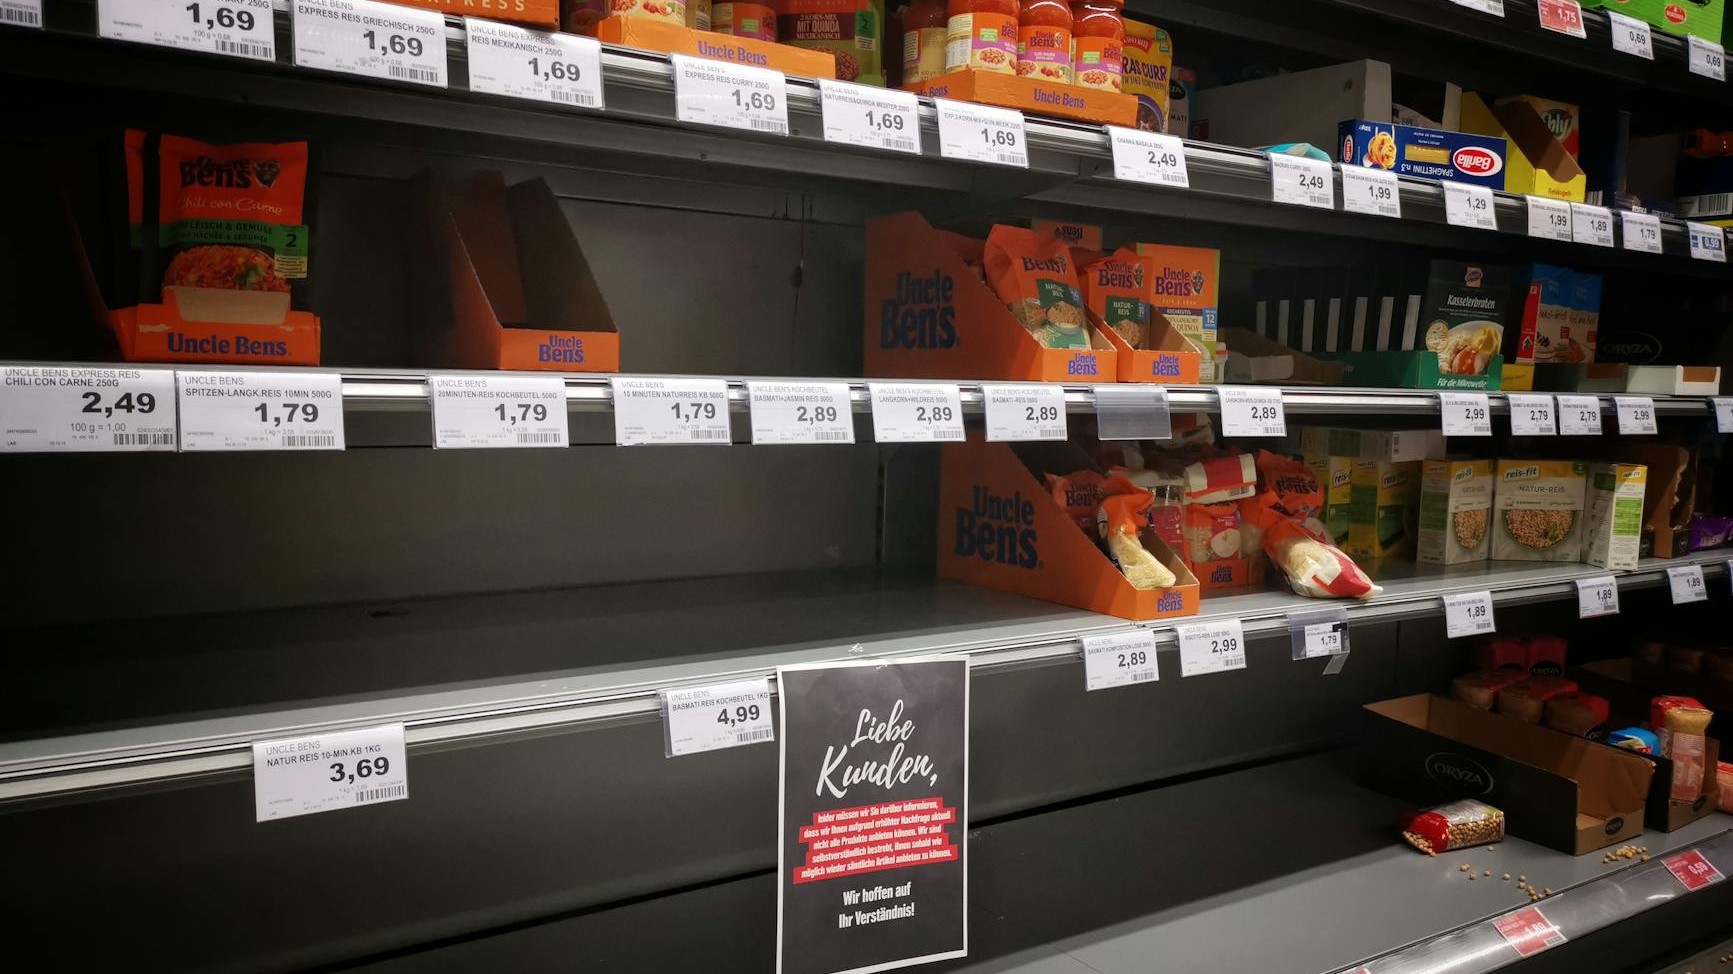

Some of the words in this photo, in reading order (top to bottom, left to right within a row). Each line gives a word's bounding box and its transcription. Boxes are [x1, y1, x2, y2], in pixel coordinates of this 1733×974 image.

[186, 3, 255, 31] 1,69
[298, 5, 339, 19] EXPRESS
[341, 13, 361, 24] REIS
[363, 17, 414, 32] GRIECHISCH
[416, 25, 435, 36] 250G
[1557, 7, 1577, 23] 1,75
[811, 21, 840, 33] QUINOA
[862, 20, 871, 29] 2
[363, 30, 423, 57] 1,69
[470, 24, 497, 36] UNCLE
[520, 33, 557, 46] EXPRESS
[1629, 31, 1647, 45] 0,69
[471, 35, 490, 45] REIS
[491, 38, 543, 55] MEXIKANISCH
[544, 46, 564, 58] 250G
[698, 41, 735, 60] Uncle
[528, 57, 581, 82] 1,69
[1706, 54, 1722, 68] 0,69
[684, 71, 716, 82] EXPRESS
[717, 74, 732, 84] REIS
[732, 78, 753, 88] CURRY
[731, 89, 776, 112] 1,69
[1034, 88, 1060, 105] Uncle
[865, 110, 904, 132] 1,69
[981, 128, 1016, 148] 1,69
[1147, 150, 1177, 168] 2,49
[1457, 153, 1492, 172] Barilla
[1298, 174, 1324, 189] 2,49
[1368, 184, 1391, 200] 1,99
[1466, 196, 1487, 211] 1,29
[1549, 214, 1567, 227] 1,99
[1590, 219, 1607, 233] 1,89
[286, 233, 297, 248] 2
[1640, 228, 1656, 241] 1,79
[1163, 266, 1191, 281] Uncle
[896, 269, 954, 306] Uncle
[1446, 293, 1496, 310] Kasselerbraten
[1205, 313, 1215, 324] 12
[167, 331, 231, 355] Uncle
[549, 335, 584, 349] Uncle
[1074, 352, 1098, 366] Uncle
[1158, 353, 1181, 367] Uncle
[5, 369, 38, 378] UNCLE
[41, 369, 69, 379] BENS
[70, 370, 117, 379] EXPRESS
[118, 370, 141, 380] REIS
[5, 377, 32, 387] CHILI
[34, 378, 57, 387] CON
[59, 378, 94, 388] CARNE
[96, 379, 120, 388] 250G
[185, 376, 216, 386] UNCLE
[219, 377, 245, 386] BENS
[437, 380, 463, 388] UNCLE
[284, 389, 309, 399] 10MIN
[311, 389, 332, 399] 500G
[496, 391, 540, 399] KOCHBEUTEL
[623, 390, 631, 398] 10
[632, 390, 661, 398] MINUTEN
[662, 391, 699, 399] NATURREIS
[81, 391, 156, 418] 2,49
[671, 402, 717, 424] 1,79
[254, 402, 319, 428] 1,79
[494, 403, 547, 427] 1,79
[796, 405, 838, 426] 2,89
[916, 406, 953, 425] 2,89
[1025, 406, 1057, 424] 2,89
[1251, 406, 1277, 422] 2,89
[1465, 408, 1485, 422] 2,99
[1530, 410, 1549, 423] 2,79
[1580, 411, 1598, 423] 2,79
[1634, 410, 1650, 423] 2,99
[71, 423, 86, 432] 100
[89, 425, 96, 434] g
[1504, 466, 1538, 479] reis-fit
[1519, 485, 1566, 494] NATUR-REIS
[973, 484, 1035, 526] Uncle
[1686, 576, 1702, 589] 1,89
[1162, 590, 1183, 602] Uncle
[1596, 588, 1613, 603] 1,89
[1467, 605, 1486, 620] 1,89
[1211, 638, 1238, 655] 2,99
[1320, 634, 1338, 646] 1,79
[1117, 651, 1147, 670] 2,89
[672, 702, 700, 711] BASMATI
[700, 699, 715, 708] REIS
[716, 694, 755, 706] KOCHBEUTEL
[756, 691, 769, 700] 1KG
[716, 704, 760, 728] 4,99
[850, 699, 916, 749] Liebe
[266, 744, 296, 756] UNCLE
[297, 740, 321, 751] BENS
[266, 755, 298, 768] NATUR
[299, 753, 320, 763] REIS
[364, 744, 382, 754] 1KG
[329, 756, 390, 785] 3,69
[815, 742, 939, 799] Kunden,
[1432, 761, 1484, 788] ORYZA
[818, 813, 835, 824] leider
[835, 811, 859, 822] müssen
[859, 809, 870, 818] wir
[870, 807, 880, 816] Sie
[880, 804, 903, 815] darüber
[903, 801, 938, 814] informieren,
[804, 828, 820, 839] dass
[820, 827, 831, 837] wir
[831, 824, 848, 835] Ihnen
[848, 821, 875, 834] aufgrund
[874, 817, 900, 829] erhöhter
[901, 814, 931, 826] Nachfrage
[930, 811, 951, 822] aktuell
[813, 840, 829, 851] nicht
[829, 838, 841, 849] alle
[841, 834, 868, 847] Produkte
[868, 831, 894, 843] anbieten
[893, 828, 917, 840] können.
[917, 826, 928, 836] Wir
[928, 824, 942, 834] sind
[812, 847, 867, 864] selbstverständlich
[866, 844, 894, 857] bestrebt,
[894, 841, 911, 852] Ihnen
[911, 838, 931, 849] sobald
[931, 837, 942, 846] wie
[801, 867, 825, 880] möglich
[825, 863, 846, 875] wieder
[846, 858, 876, 871] sämtliche
[875, 855, 896, 867] Artikel
[895, 852, 921, 864] anbieten
[921, 852, 929, 861] zu
[928, 849, 952, 860] können.
[843, 890, 861, 906] Wir
[862, 887, 894, 904] hoffen
[895, 881, 912, 896] auf
[838, 912, 854, 929] Ihr
[855, 902, 915, 926] Verständnis!
